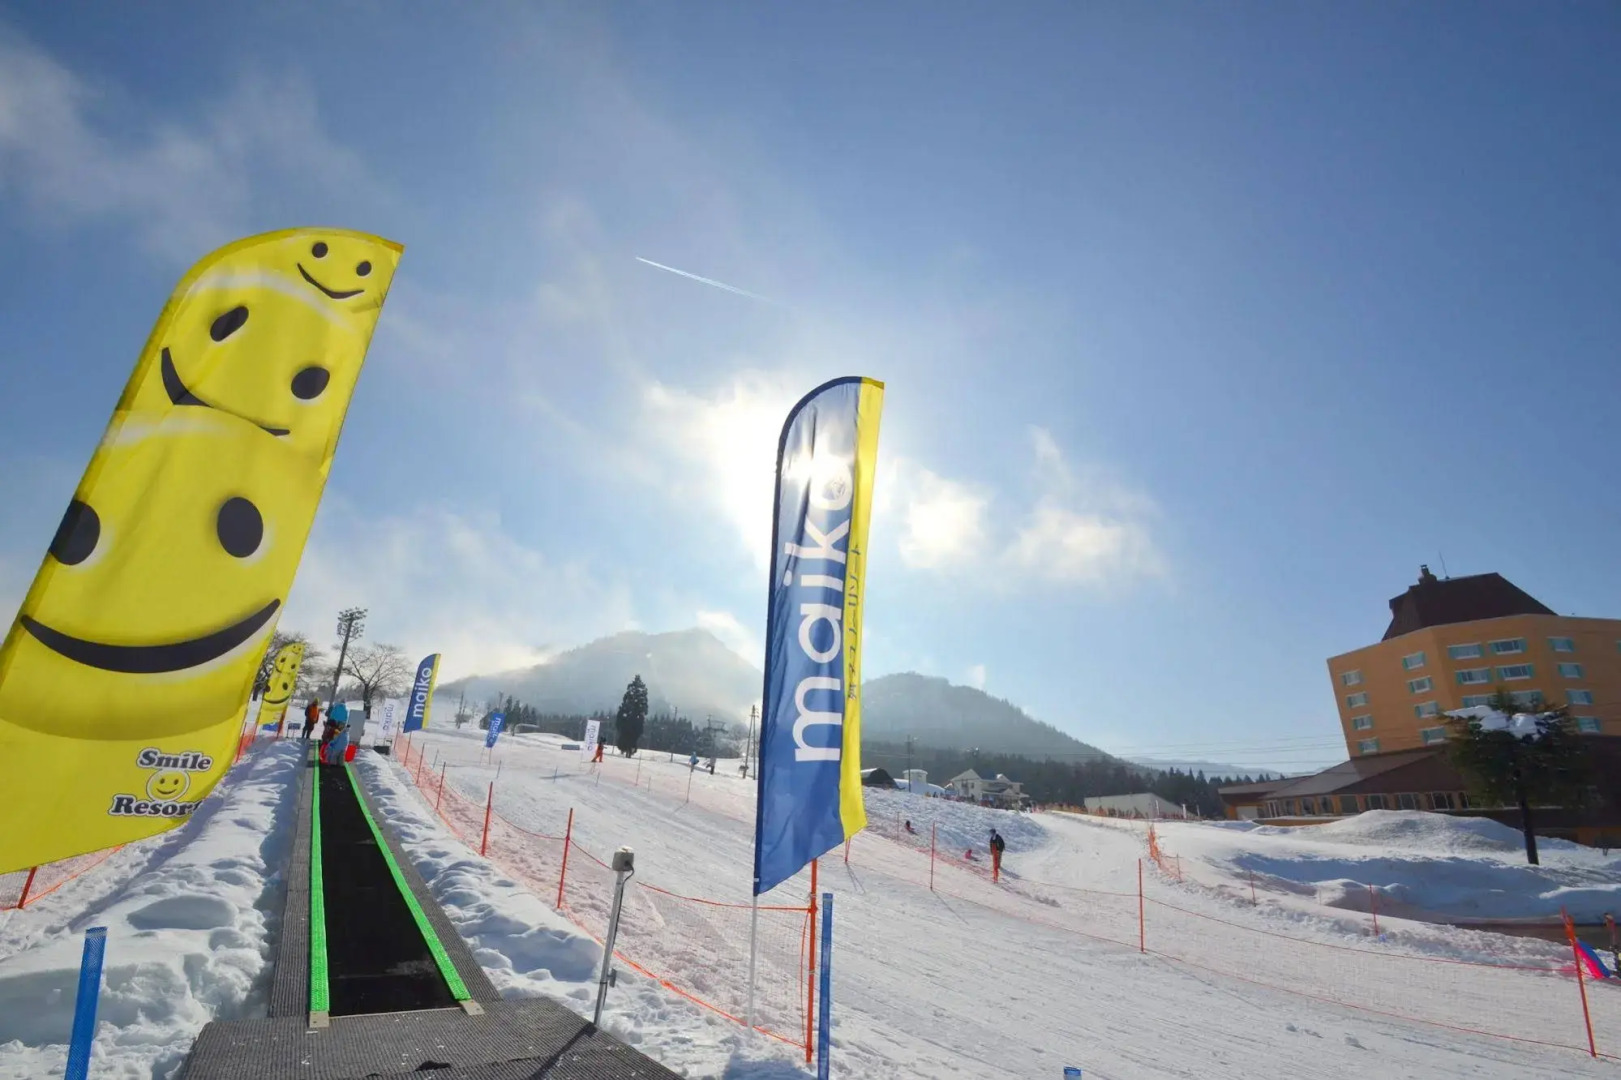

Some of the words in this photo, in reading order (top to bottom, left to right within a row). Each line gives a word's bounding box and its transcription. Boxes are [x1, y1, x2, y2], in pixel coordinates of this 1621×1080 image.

[783, 454, 853, 762] maiko
[413, 667, 432, 717] maiko
[137, 748, 212, 771] Smile
